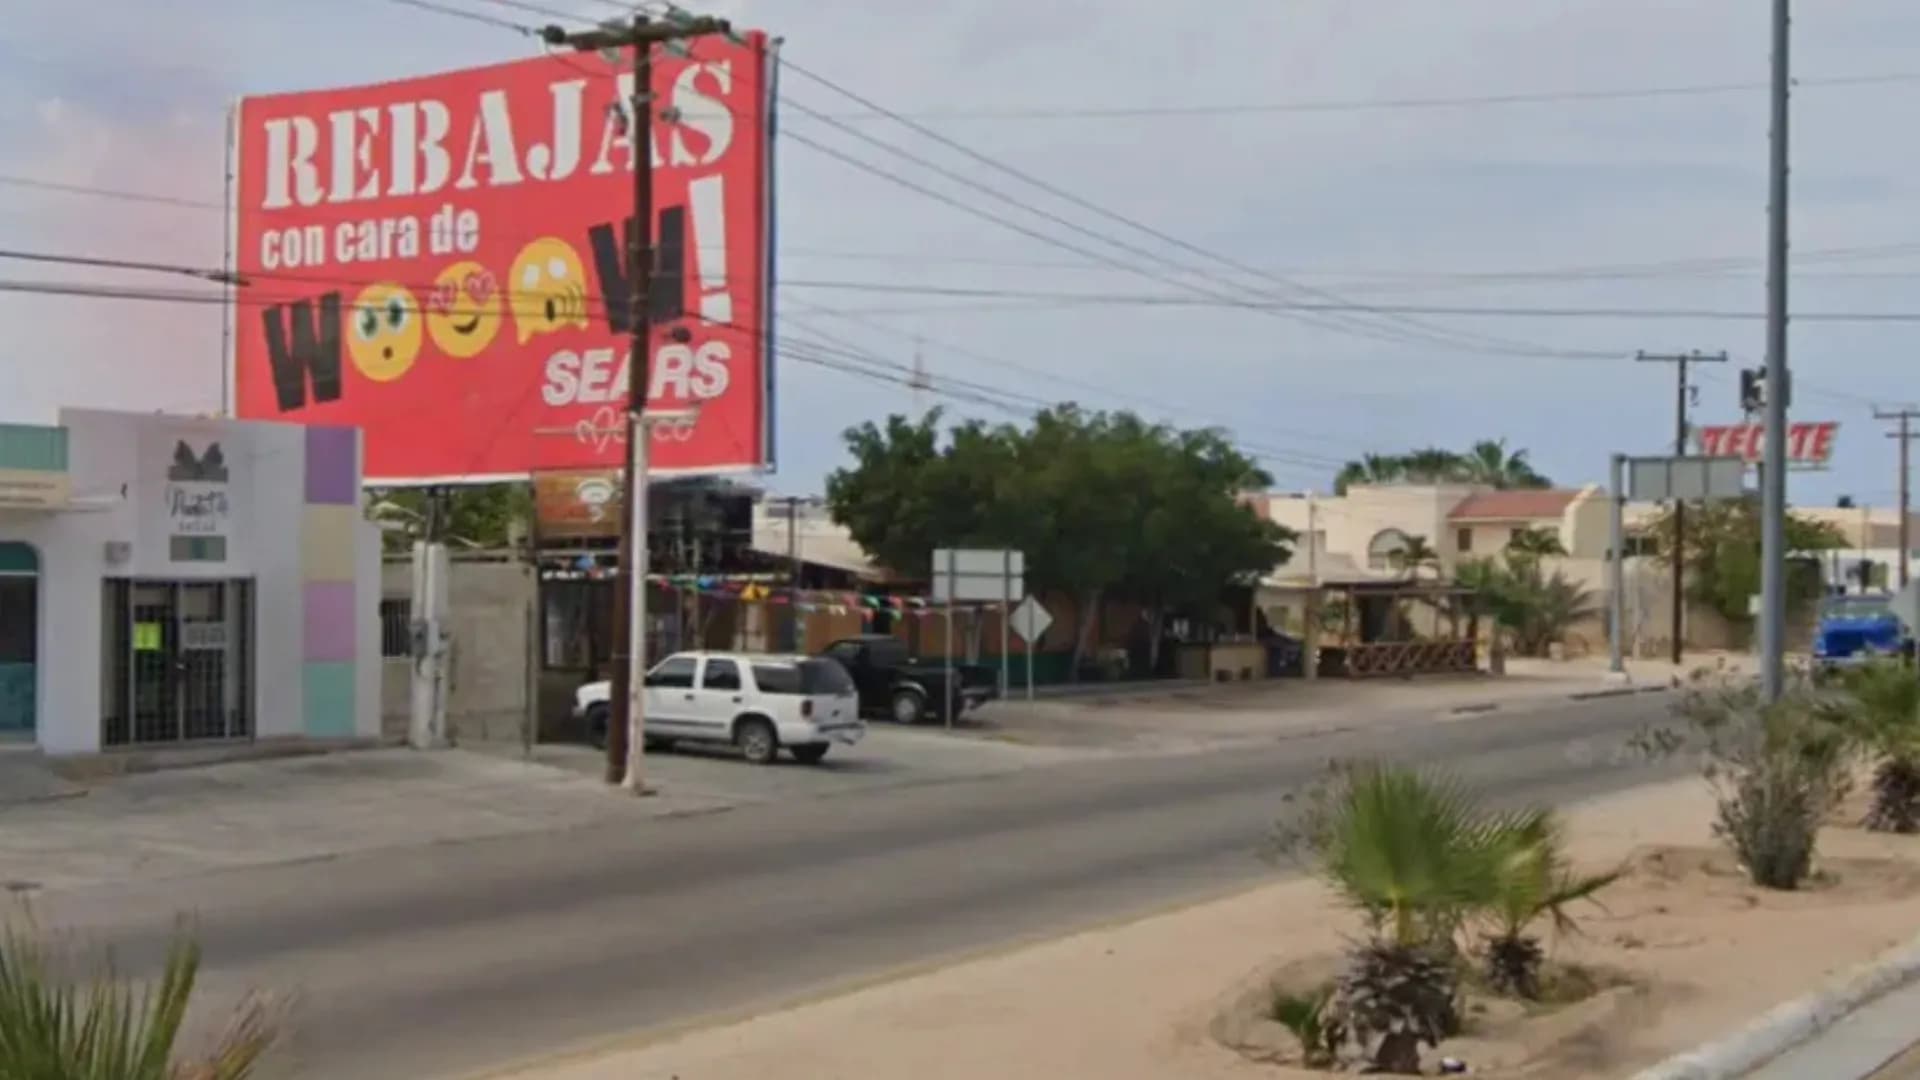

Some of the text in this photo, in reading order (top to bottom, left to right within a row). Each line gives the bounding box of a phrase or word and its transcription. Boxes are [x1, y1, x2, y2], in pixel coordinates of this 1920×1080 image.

[262, 60, 733, 209] REBAJAS
[261, 203, 479, 270] con cara de
[1702, 422, 1837, 460] TECTE
